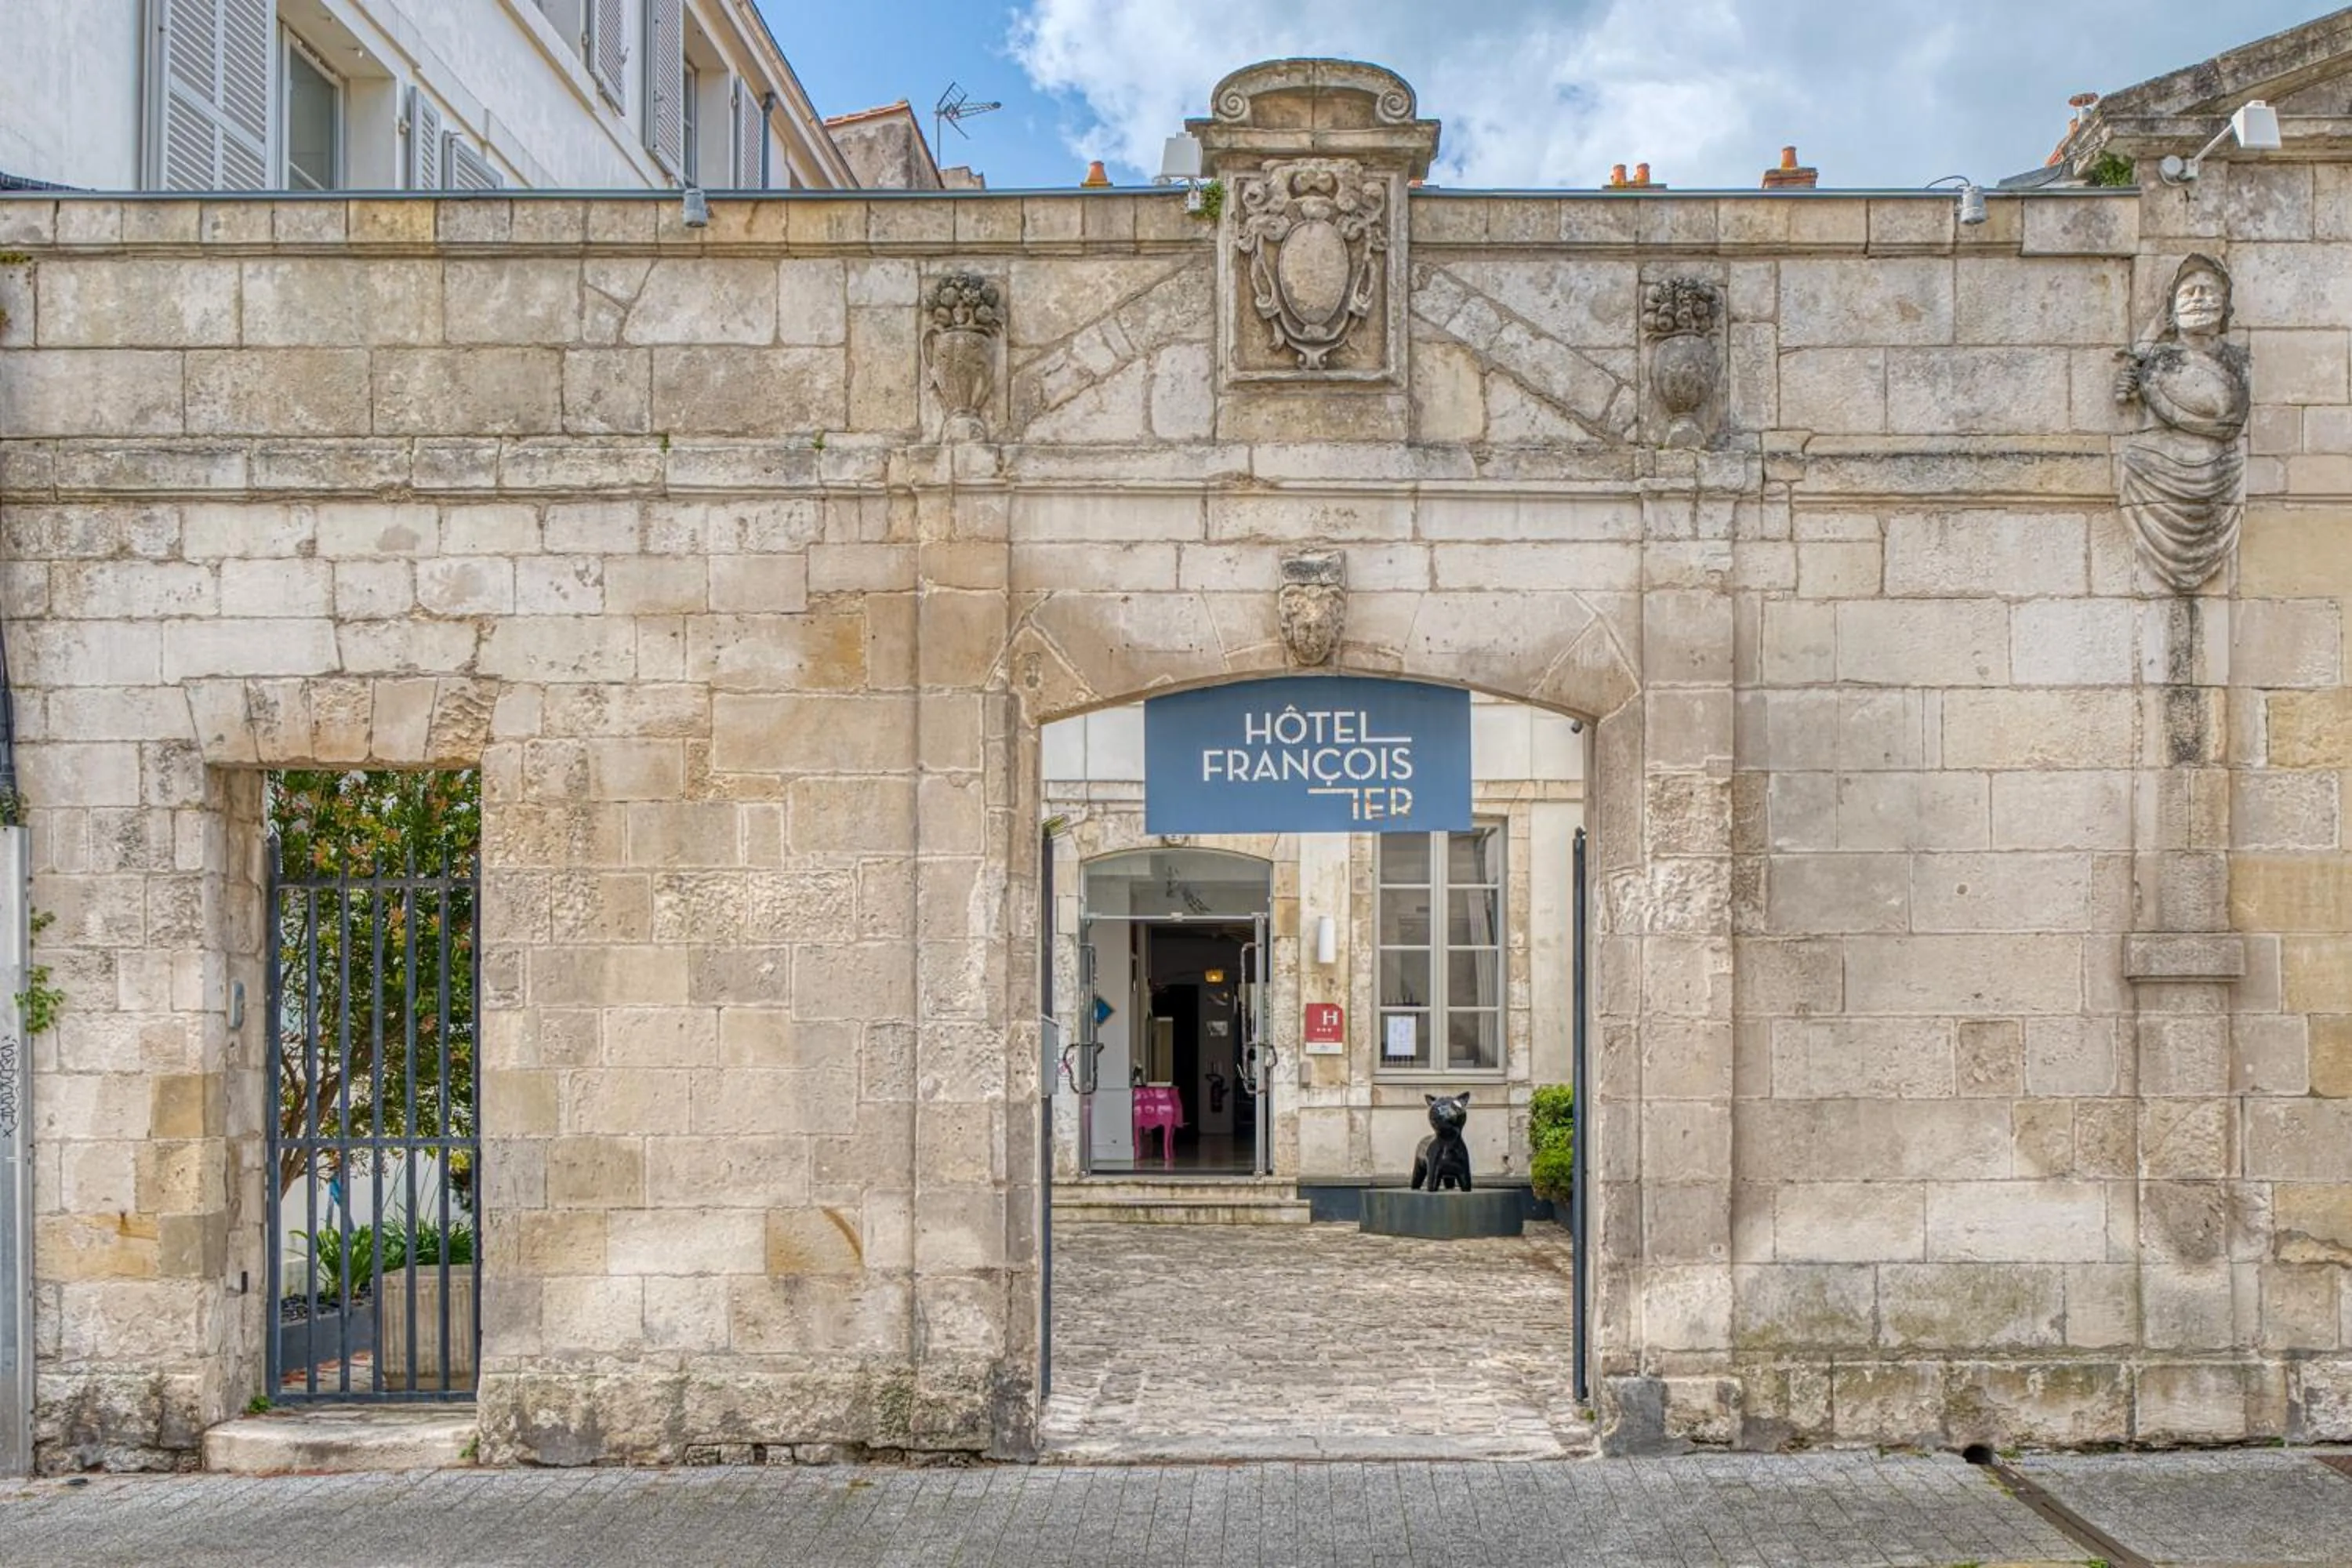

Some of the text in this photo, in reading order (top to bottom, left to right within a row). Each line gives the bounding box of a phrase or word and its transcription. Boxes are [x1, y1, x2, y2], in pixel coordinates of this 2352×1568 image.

[1245, 703, 1412, 744] HÔTEL
[1203, 747, 1413, 786] FRANÇOIS
[1323, 1010, 1338, 1025] H
